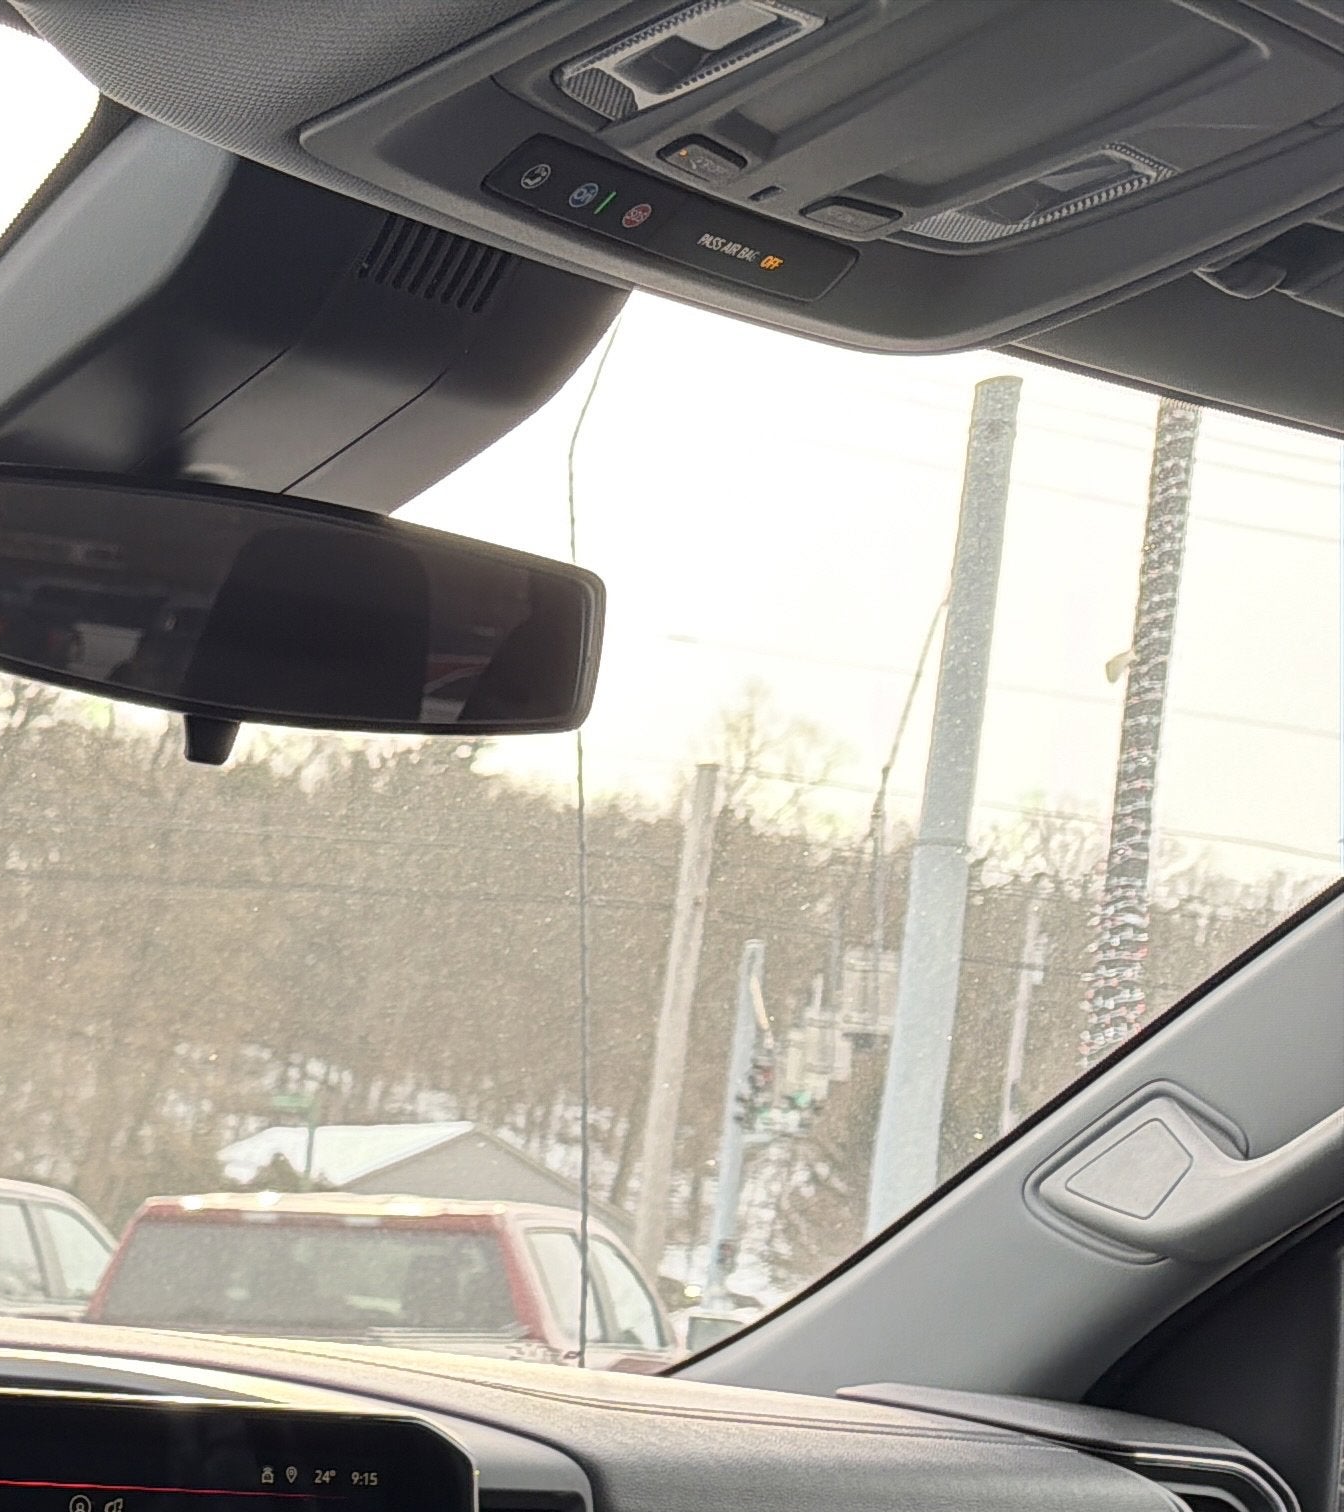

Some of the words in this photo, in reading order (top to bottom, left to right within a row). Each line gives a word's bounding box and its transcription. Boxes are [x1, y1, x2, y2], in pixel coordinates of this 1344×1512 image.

[696, 233, 726, 251] PASS
[720, 241, 742, 257] AIR
[759, 255, 784, 270] OFF
[351, 1471, 378, 1486] 9:15
